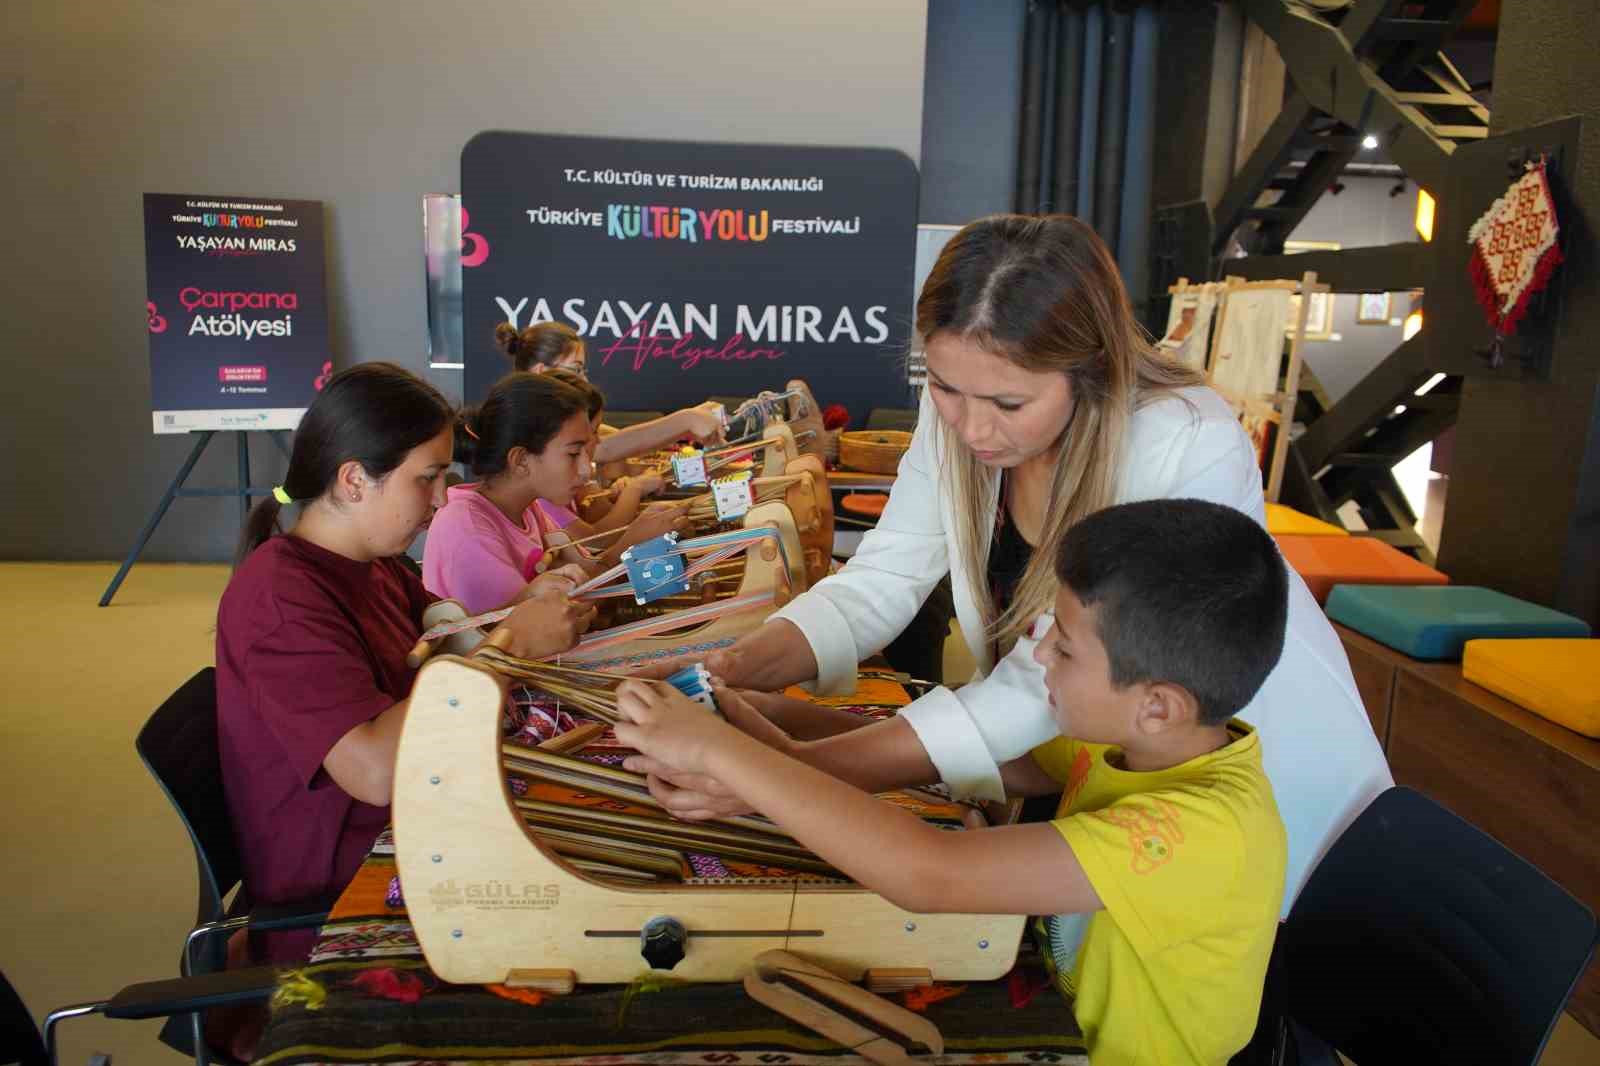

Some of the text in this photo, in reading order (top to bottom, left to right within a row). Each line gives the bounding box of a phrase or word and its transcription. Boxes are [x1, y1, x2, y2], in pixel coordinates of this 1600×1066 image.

[563, 168, 824, 192] T.C. KÜLTÜR VE TURİZM BAKANLIĞI
[525, 206, 604, 227] TÜRKİYE
[772, 215, 861, 235] FESTİVALİ
[176, 235, 246, 252] YAŞAYAN
[178, 287, 298, 313] Çarpana
[188, 313, 292, 341] Atölyesi
